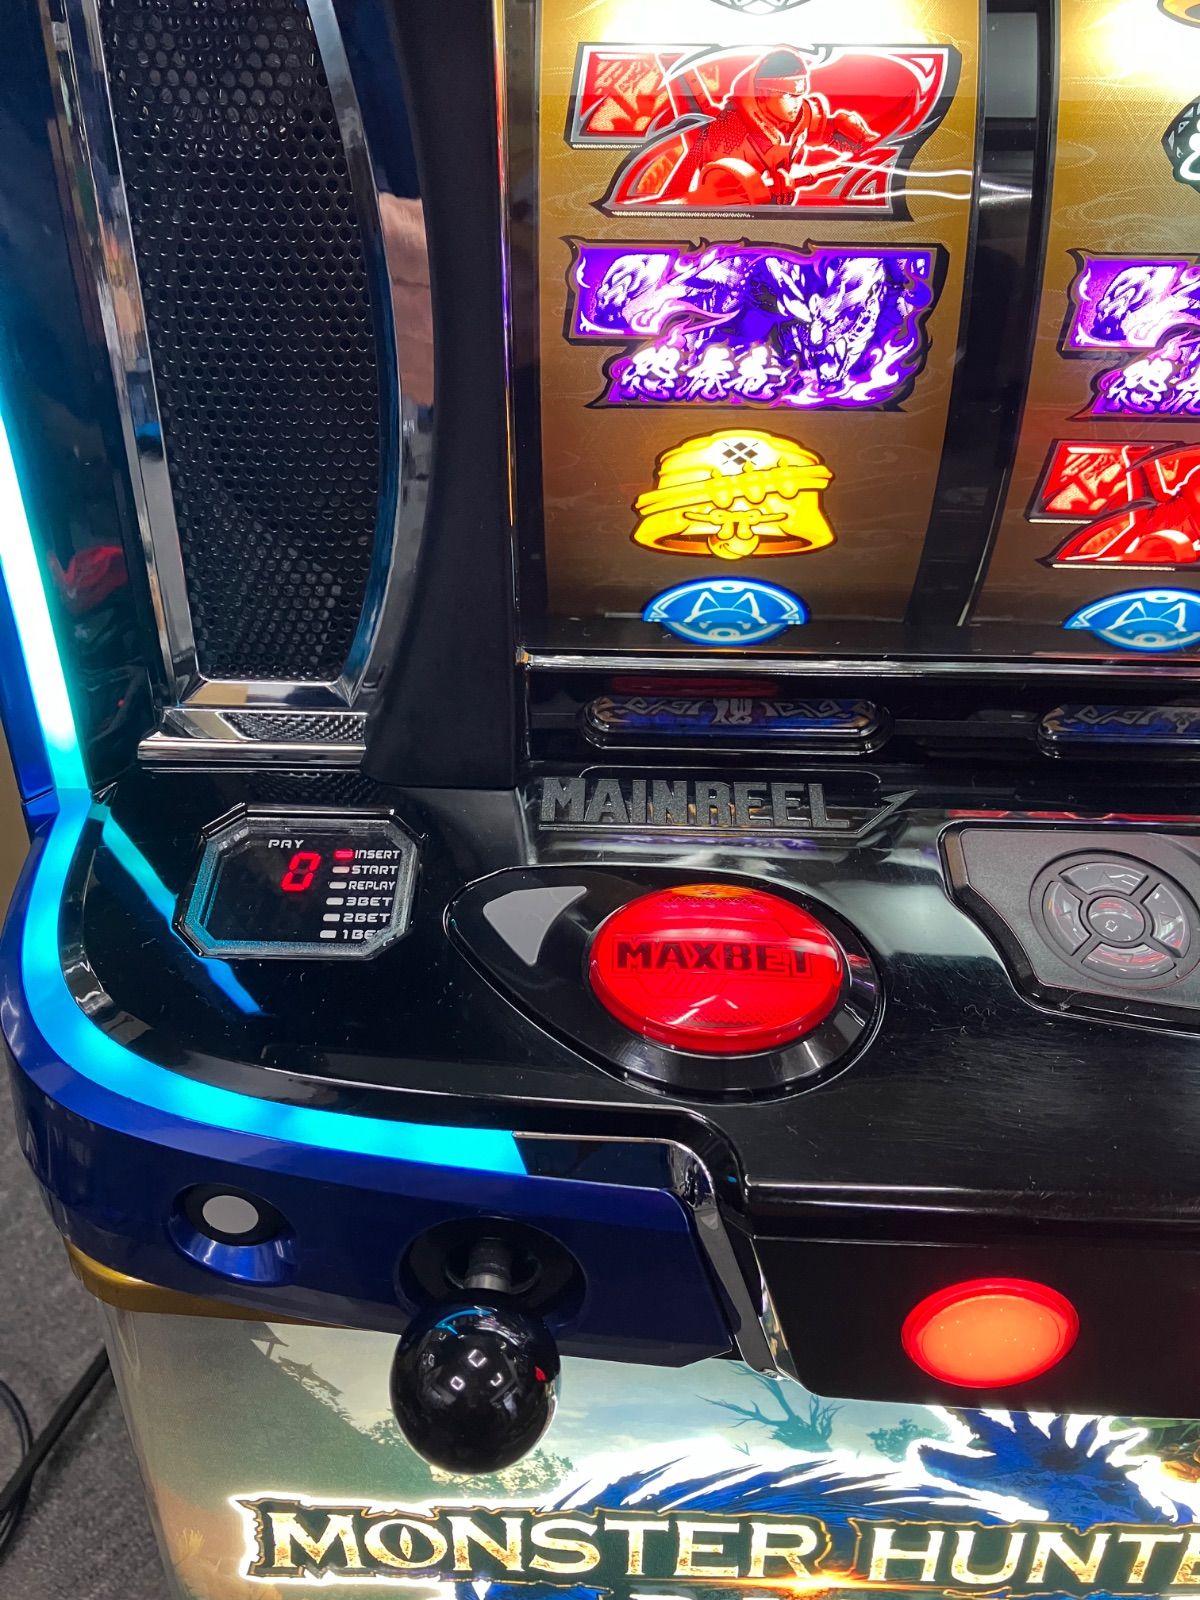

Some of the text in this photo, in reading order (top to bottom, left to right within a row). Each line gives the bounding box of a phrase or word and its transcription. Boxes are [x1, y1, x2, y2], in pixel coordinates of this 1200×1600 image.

[540, 777, 850, 828] MAINREEL
[268, 839, 304, 849] PAY
[354, 850, 400, 860] INSERT
[280, 852, 322, 891] 0
[351, 865, 398, 875] START
[348, 881, 395, 891] REPLAY
[346, 897, 393, 907] 3BET
[342, 913, 391, 923] 2BET
[342, 929, 379, 940] 1BE
[616, 940, 813, 977] MAXBET
[266, 1511, 822, 1579] MONSTER
